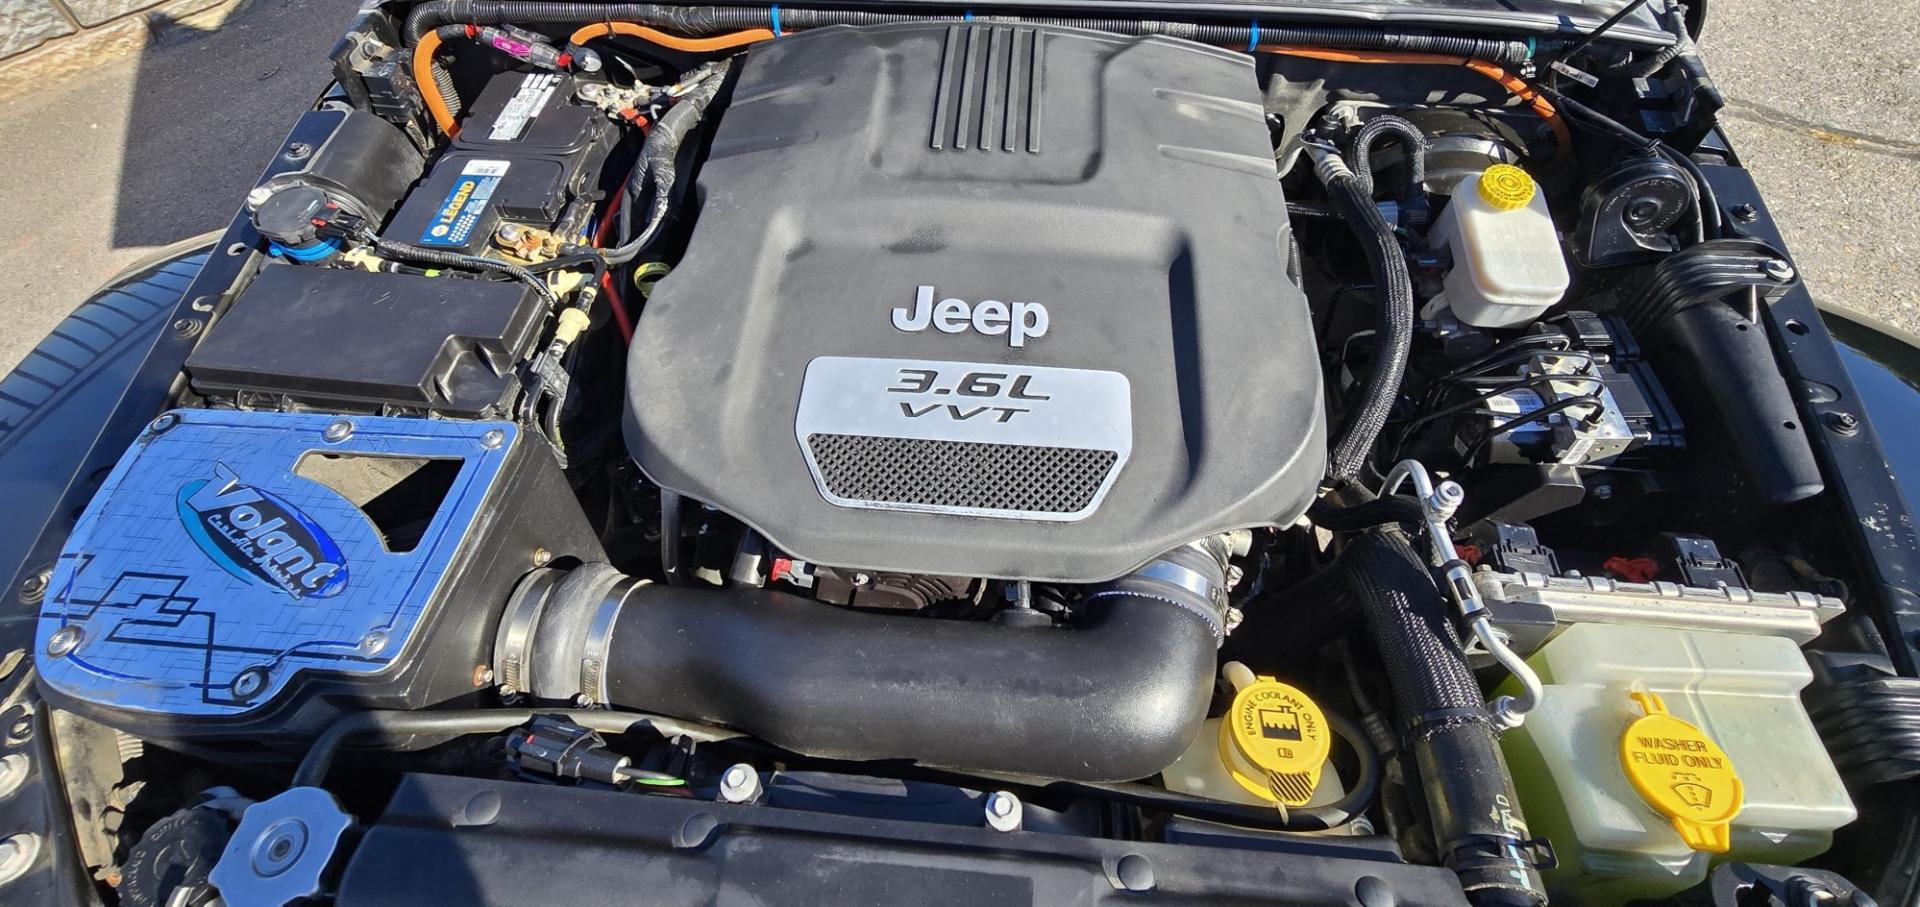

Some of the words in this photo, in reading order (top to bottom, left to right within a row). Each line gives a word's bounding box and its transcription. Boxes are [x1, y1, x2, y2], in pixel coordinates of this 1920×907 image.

[440, 181, 476, 224] LEGEND
[890, 285, 1050, 348] Jeep
[886, 369, 1051, 401] 3.6L
[900, 402, 1031, 423] VVT
[185, 459, 342, 589] Volant
[1243, 700, 1257, 736] ENGINE
[1255, 691, 1304, 711] COOLANT
[1302, 712, 1318, 741] ONLY
[1631, 751, 1680, 766] FLUID
[1681, 754, 1723, 769] ONLY
[1636, 736, 1708, 753] WASHER
